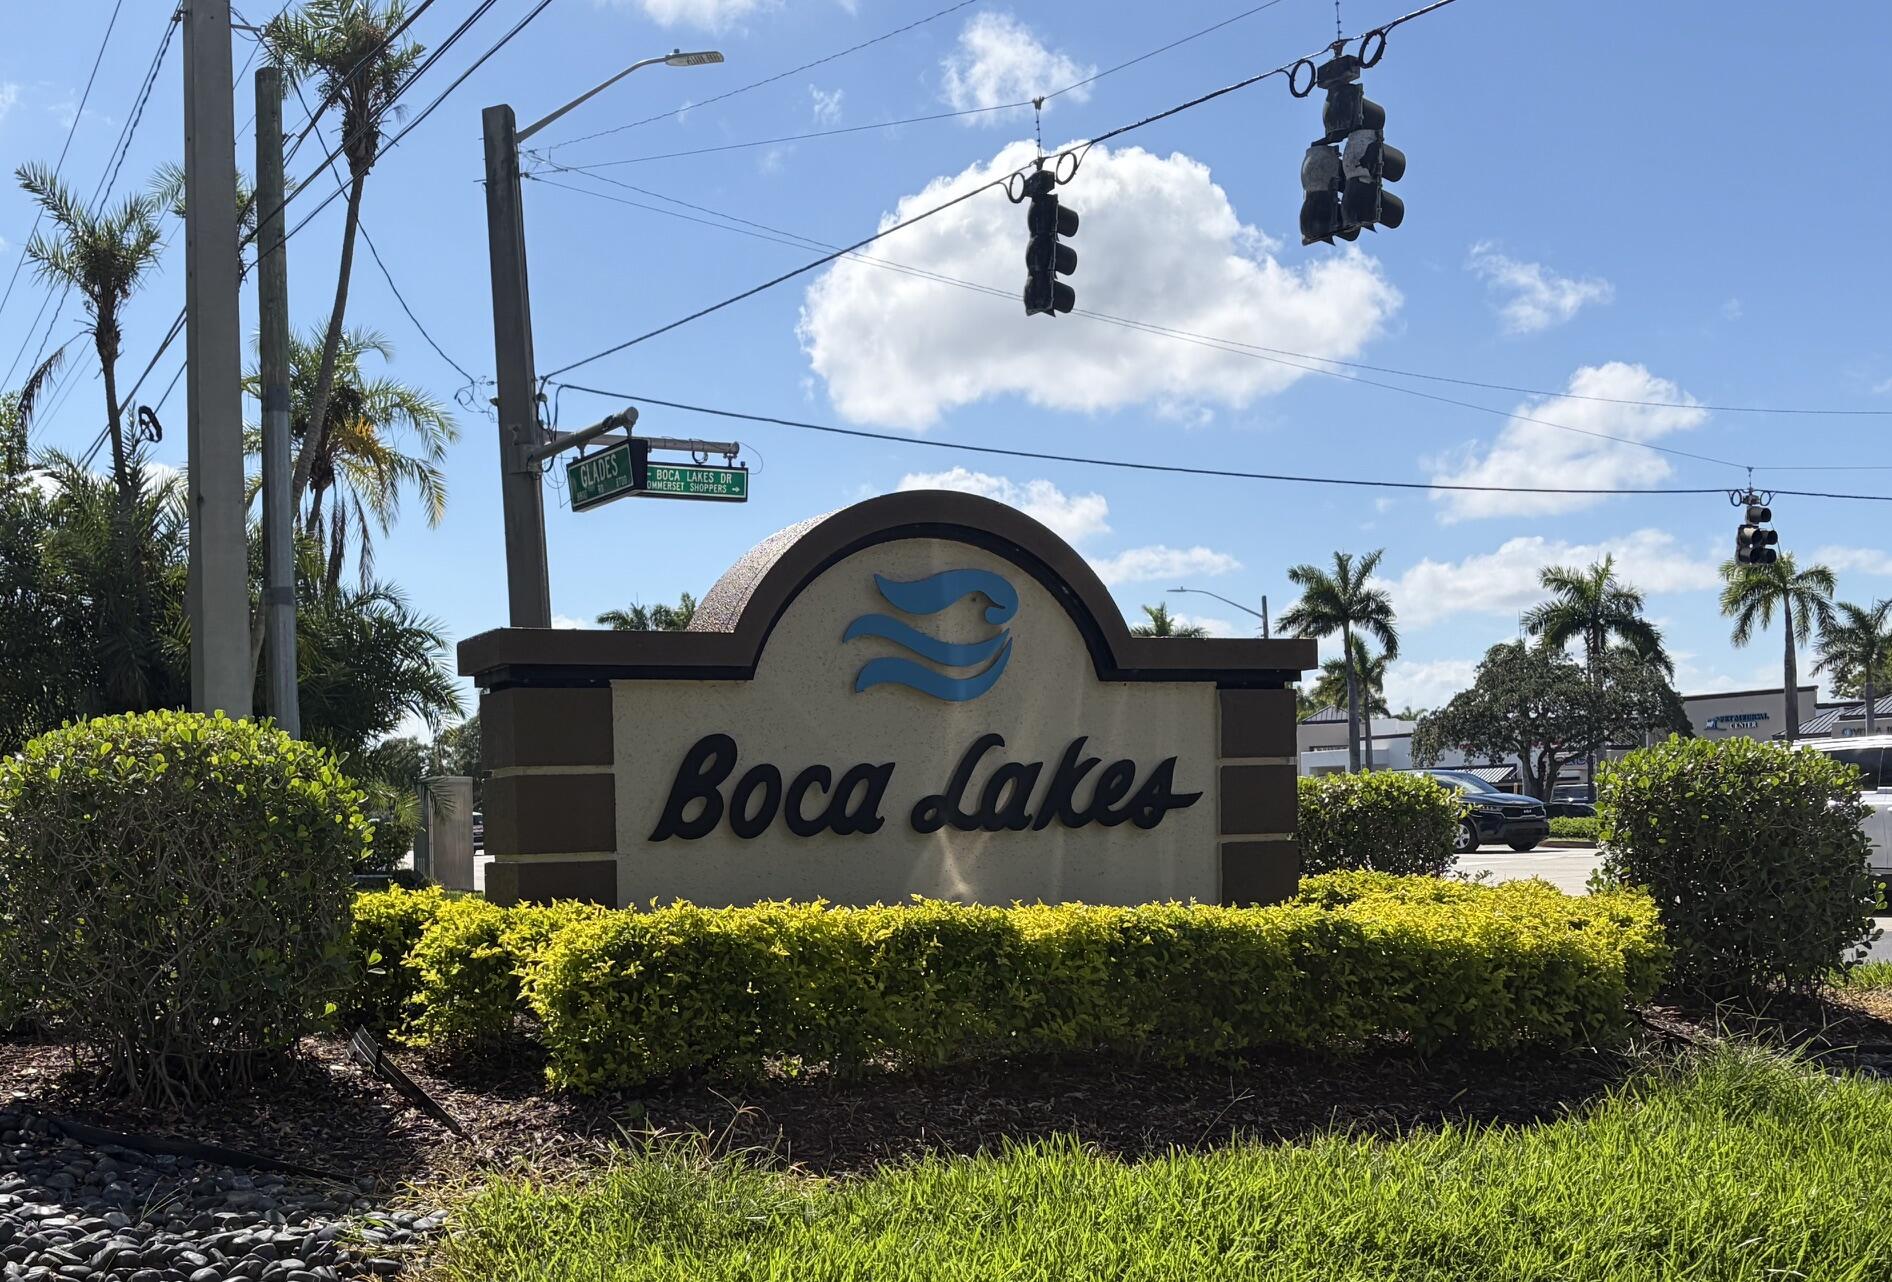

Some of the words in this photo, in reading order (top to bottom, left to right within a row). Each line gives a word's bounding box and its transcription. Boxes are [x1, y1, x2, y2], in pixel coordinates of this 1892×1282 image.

[580, 453, 618, 488] GLADES
[656, 469, 680, 481] BOCA
[686, 471, 714, 483] LAKES
[720, 473, 732, 484] DR
[647, 480, 684, 491] OMMERSET
[690, 483, 727, 493] SHOPPERS
[1729, 721, 1758, 729] CENTER
[648, 733, 896, 842] Boca
[910, 733, 1204, 834] Lakes
